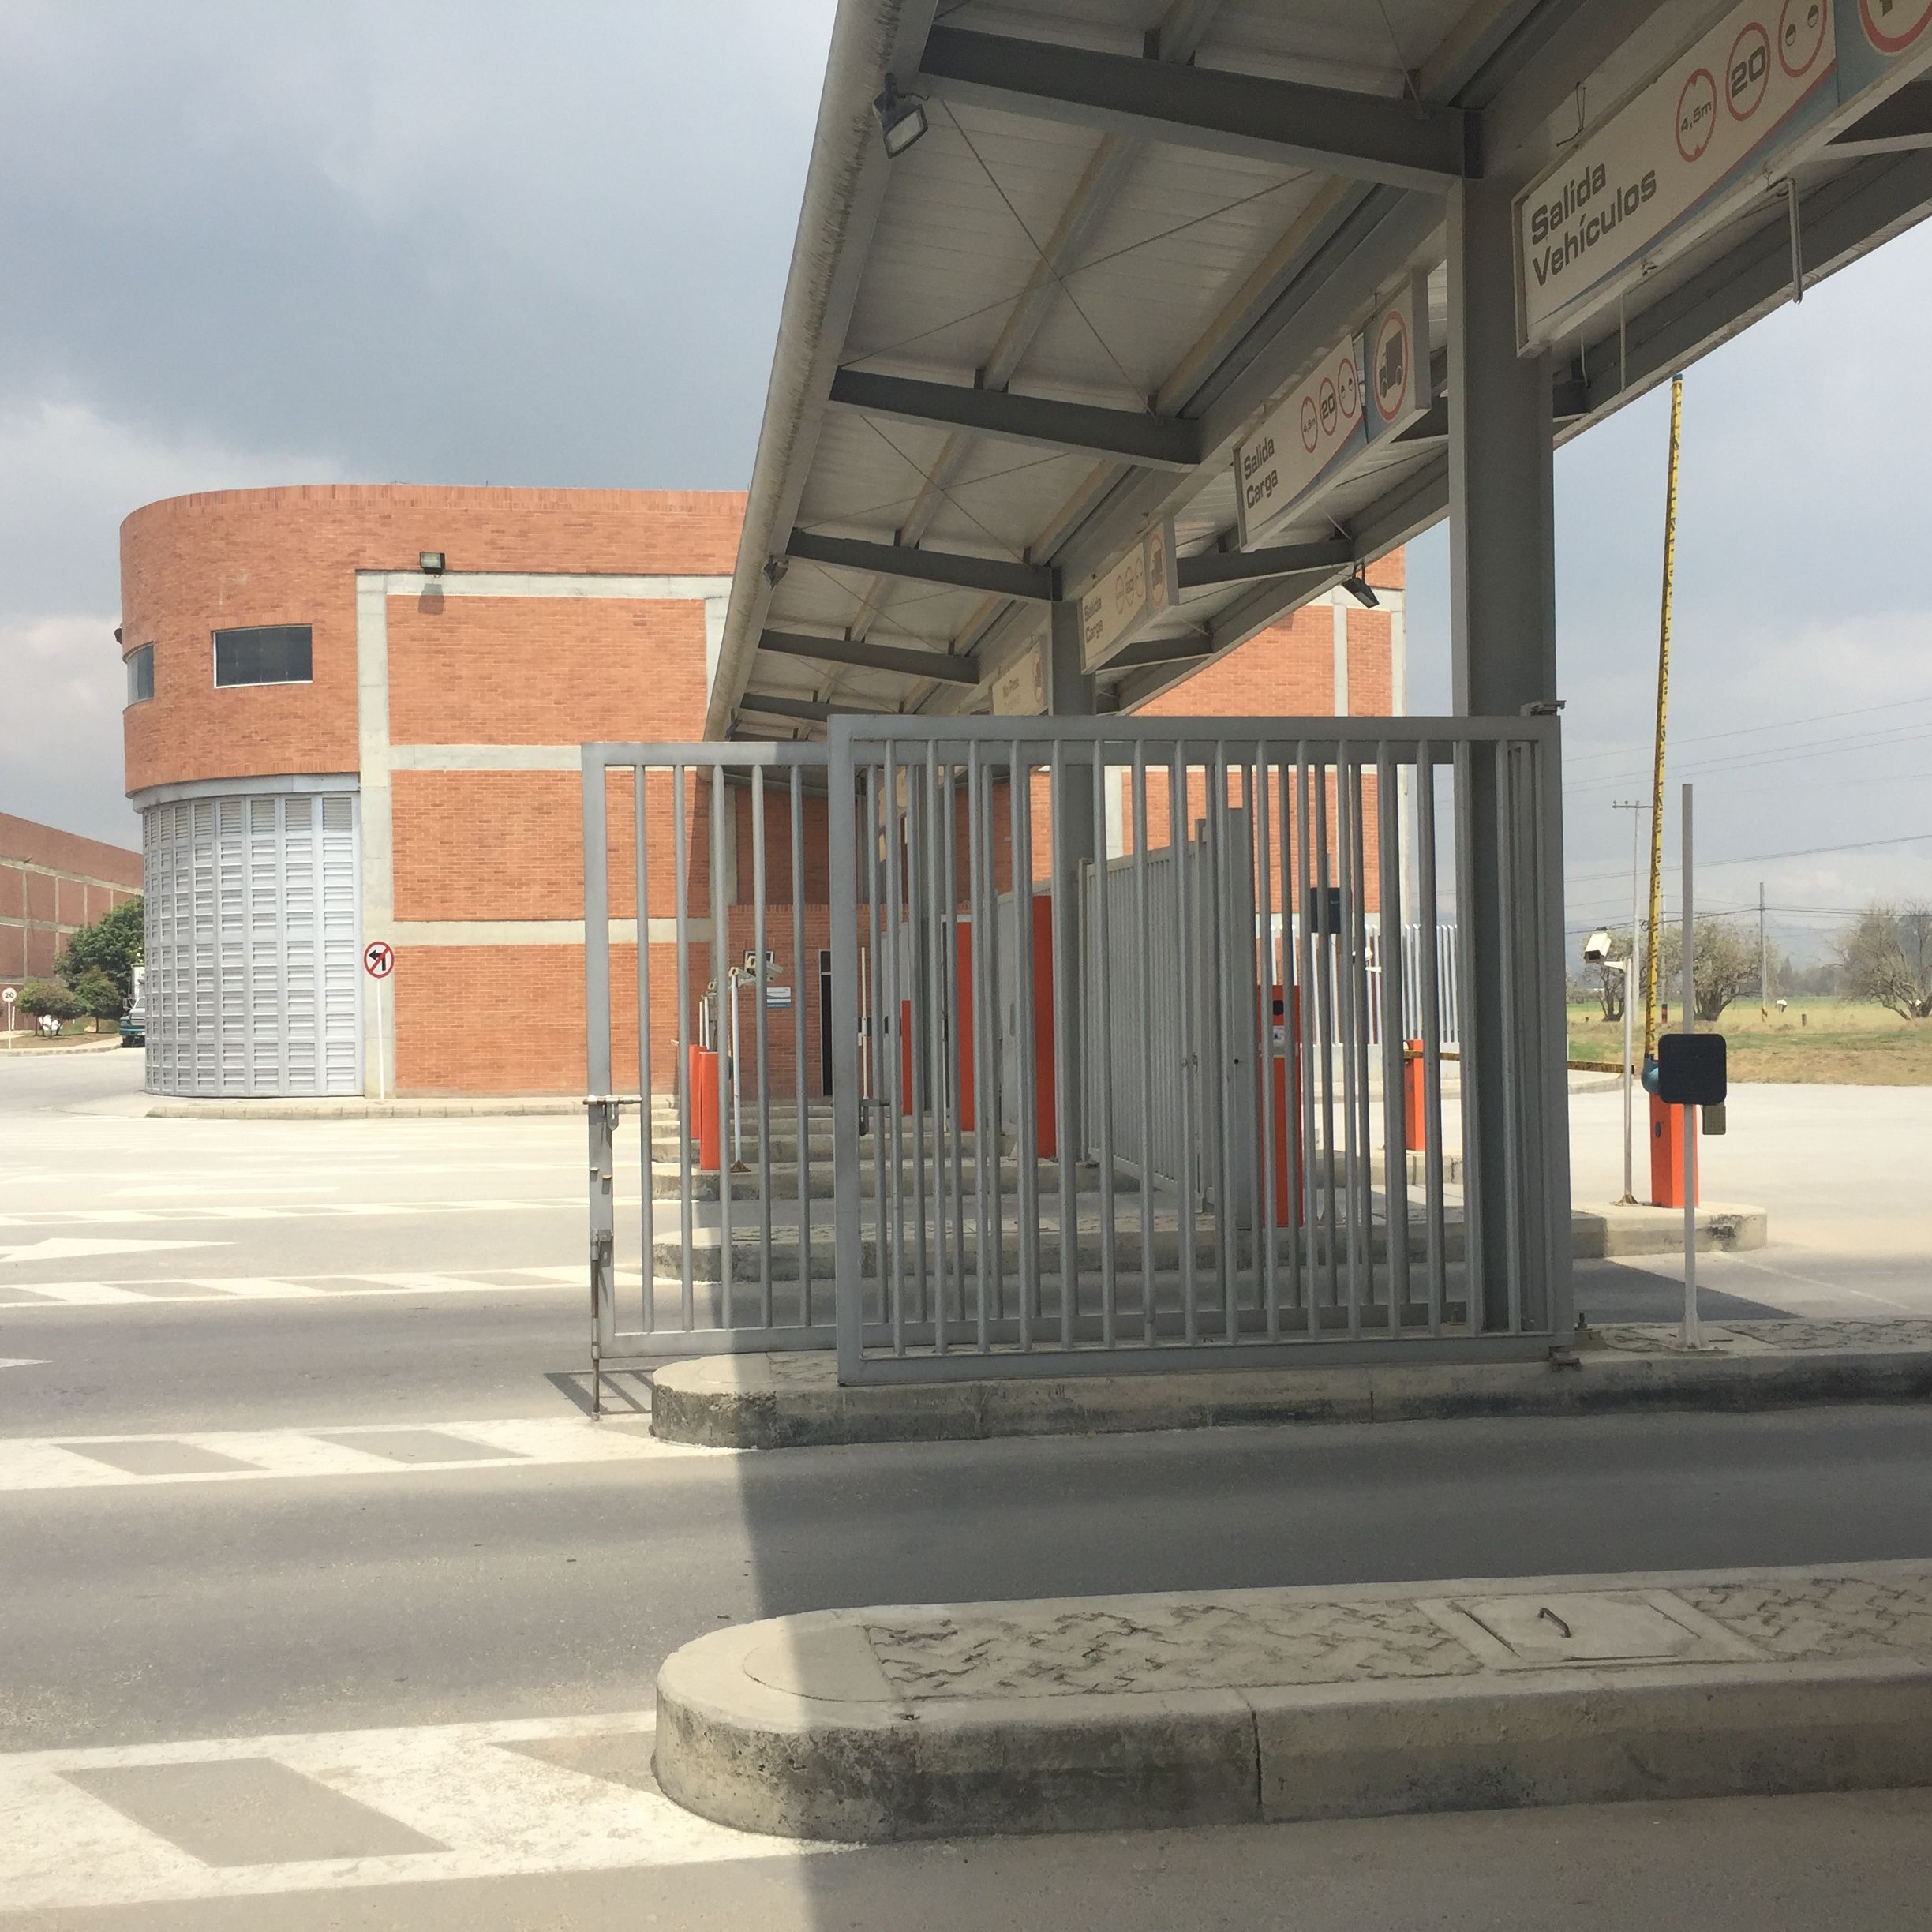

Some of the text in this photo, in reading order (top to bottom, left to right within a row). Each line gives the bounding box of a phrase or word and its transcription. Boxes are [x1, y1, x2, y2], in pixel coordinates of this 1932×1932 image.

[1731, 46, 1766, 99] 20
[1681, 101, 1712, 133] 4,5m
[1532, 163, 1606, 245] Salida
[1533, 170, 1657, 286] Vehículos
[1321, 392, 1335, 420] 20
[1244, 436, 1275, 481] Salida
[1247, 469, 1278, 509] Carga
[1085, 619, 1103, 644] Carga
